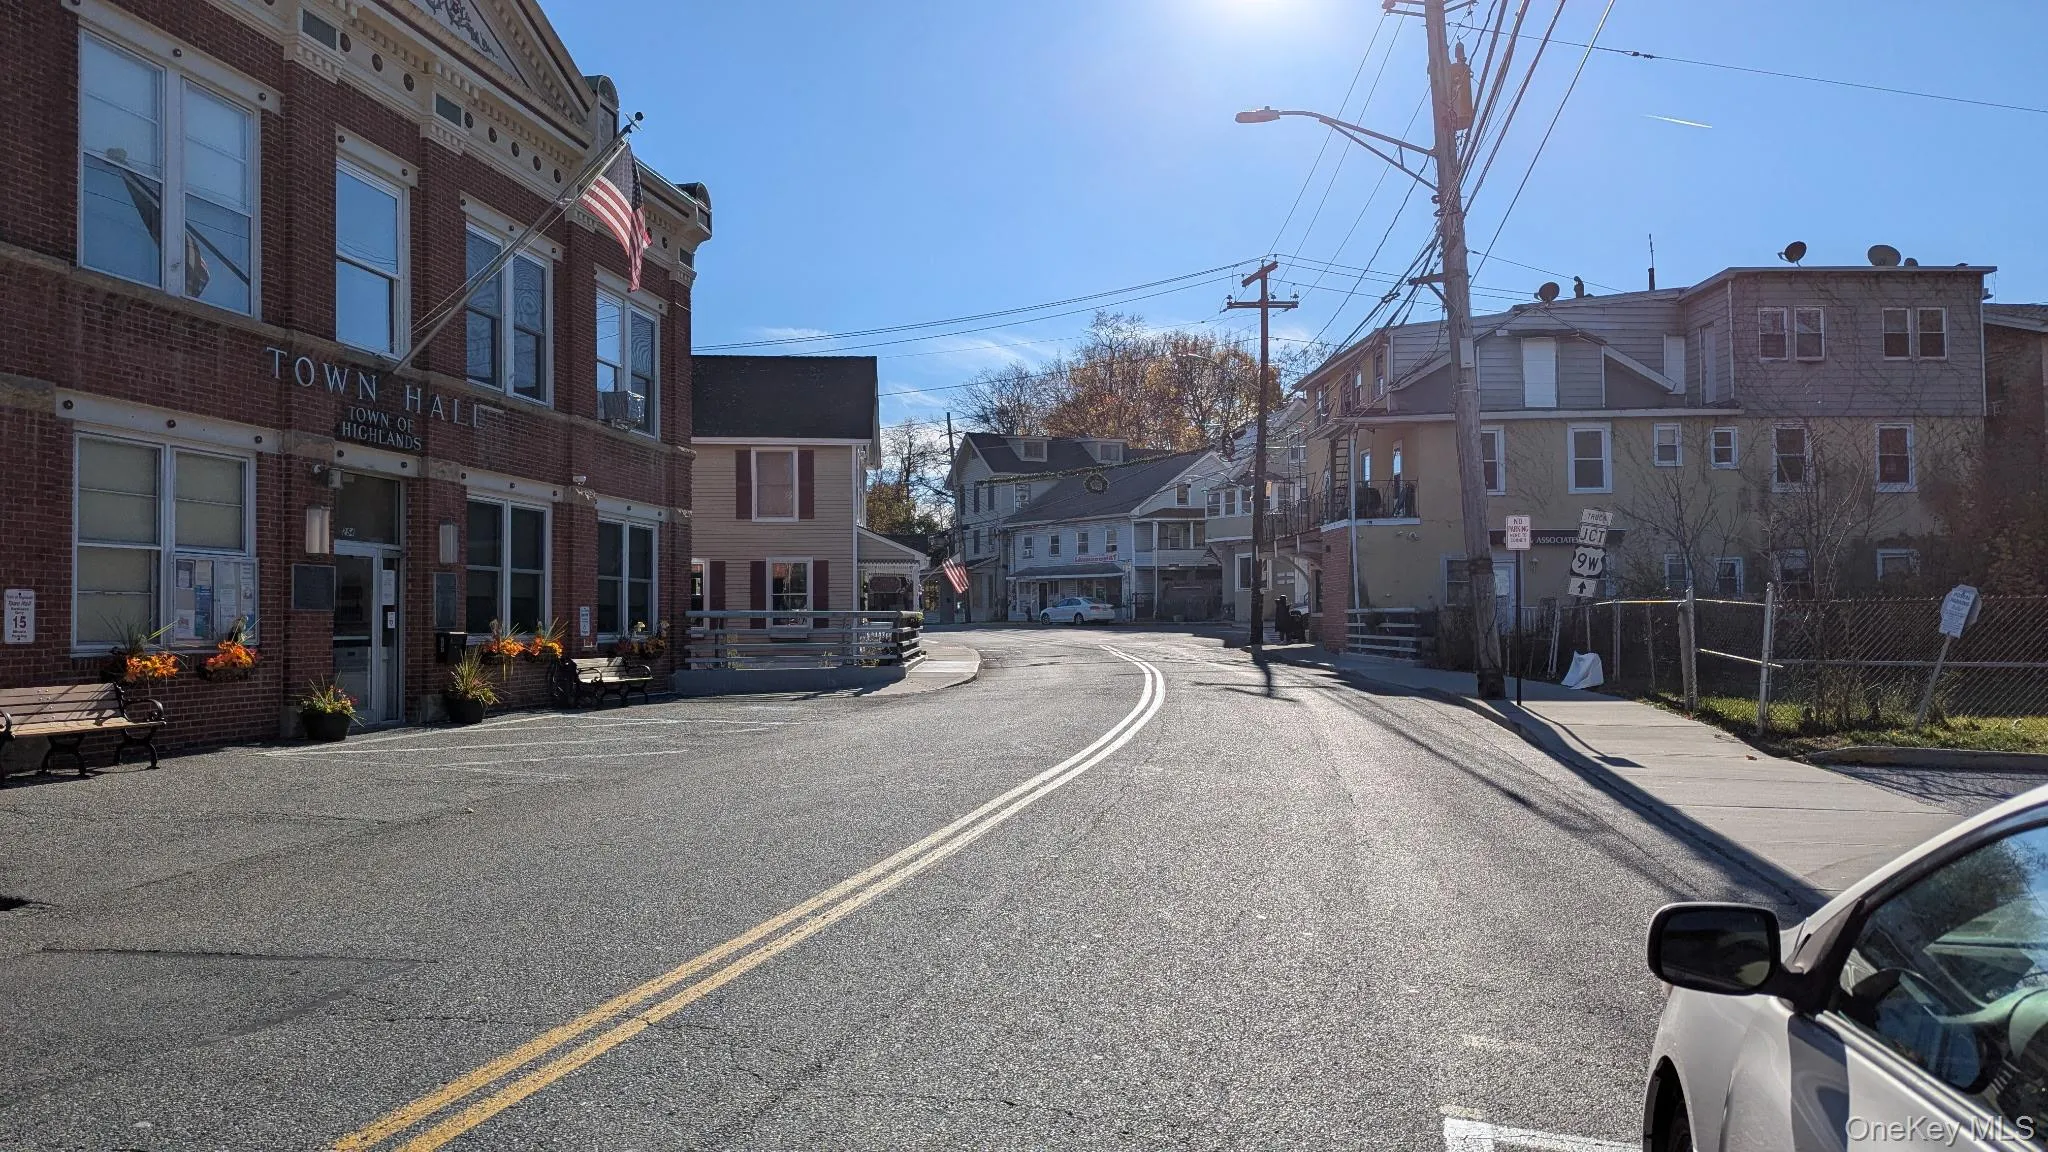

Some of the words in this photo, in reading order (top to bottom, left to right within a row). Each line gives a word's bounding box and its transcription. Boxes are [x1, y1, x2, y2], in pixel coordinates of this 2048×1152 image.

[266, 347, 378, 402] TOWN
[405, 384, 482, 428] HALL
[350, 406, 389, 427] TOWN
[397, 417, 414, 432] OF
[342, 421, 422, 451] HIGHLANDS
[1586, 513, 1608, 521] TRUCK
[1580, 529, 1606, 544] JCT
[13, 616, 27, 629] 15
